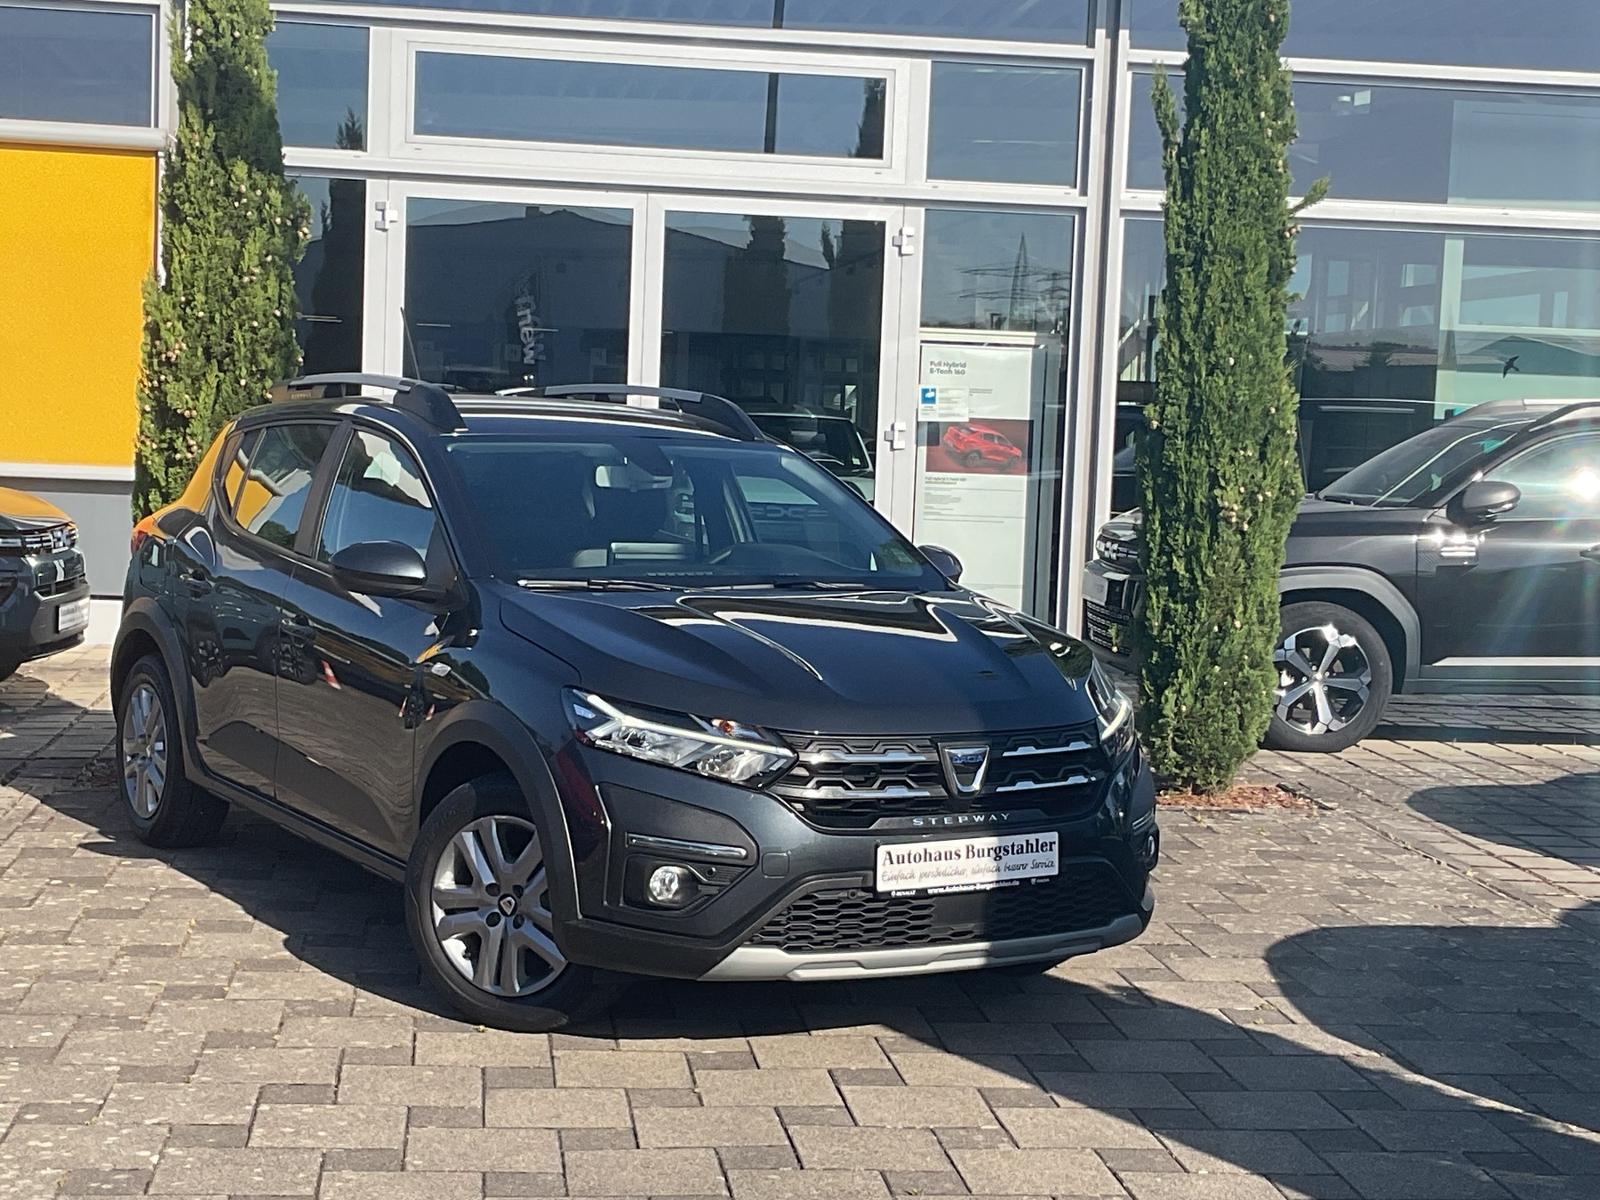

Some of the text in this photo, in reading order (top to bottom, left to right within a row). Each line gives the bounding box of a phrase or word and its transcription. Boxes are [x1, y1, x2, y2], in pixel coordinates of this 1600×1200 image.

[943, 361, 967, 370] Hybrid
[912, 813, 1010, 826] STEPWAY
[881, 838, 1056, 867] Autohaus Burgstahler
[881, 868, 916, 884] Einfach
[1030, 858, 1056, 870] Service
